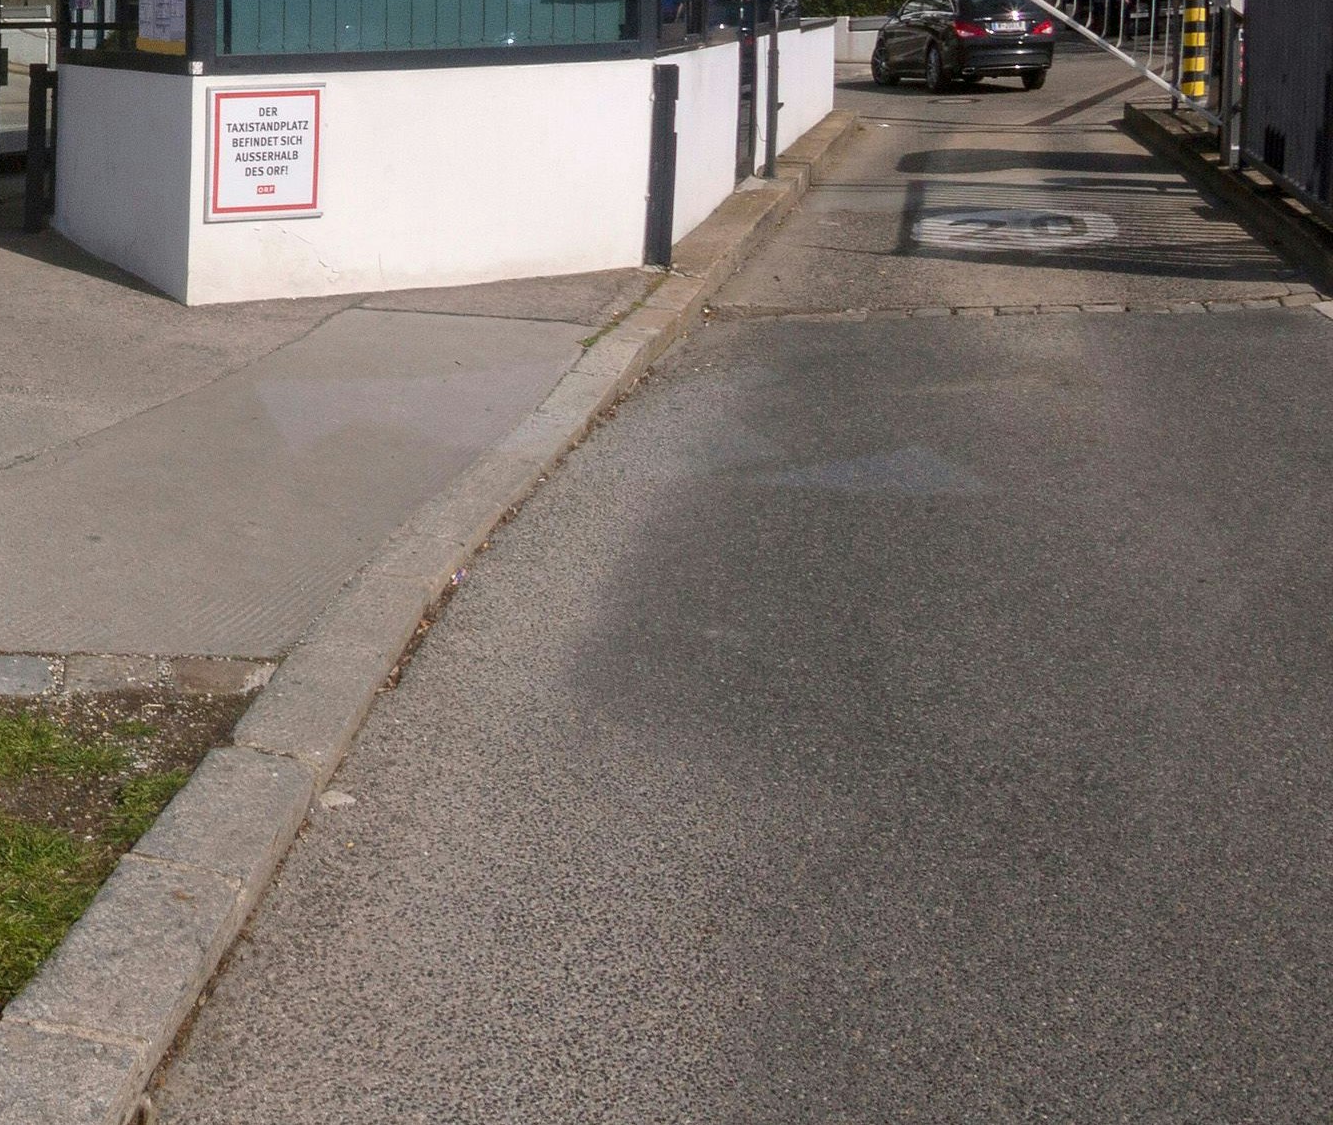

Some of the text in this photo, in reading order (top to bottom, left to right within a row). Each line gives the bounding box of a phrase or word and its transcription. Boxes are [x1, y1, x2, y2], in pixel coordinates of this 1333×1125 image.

[258, 107, 278, 117] DER
[226, 120, 309, 133] TAXISTANDPLATZ
[232, 135, 303, 147] BEFINDET SICH
[235, 150, 299, 162] AUSSERHALB
[245, 165, 289, 177] DES ORF!
[257, 186, 275, 194] ORF
